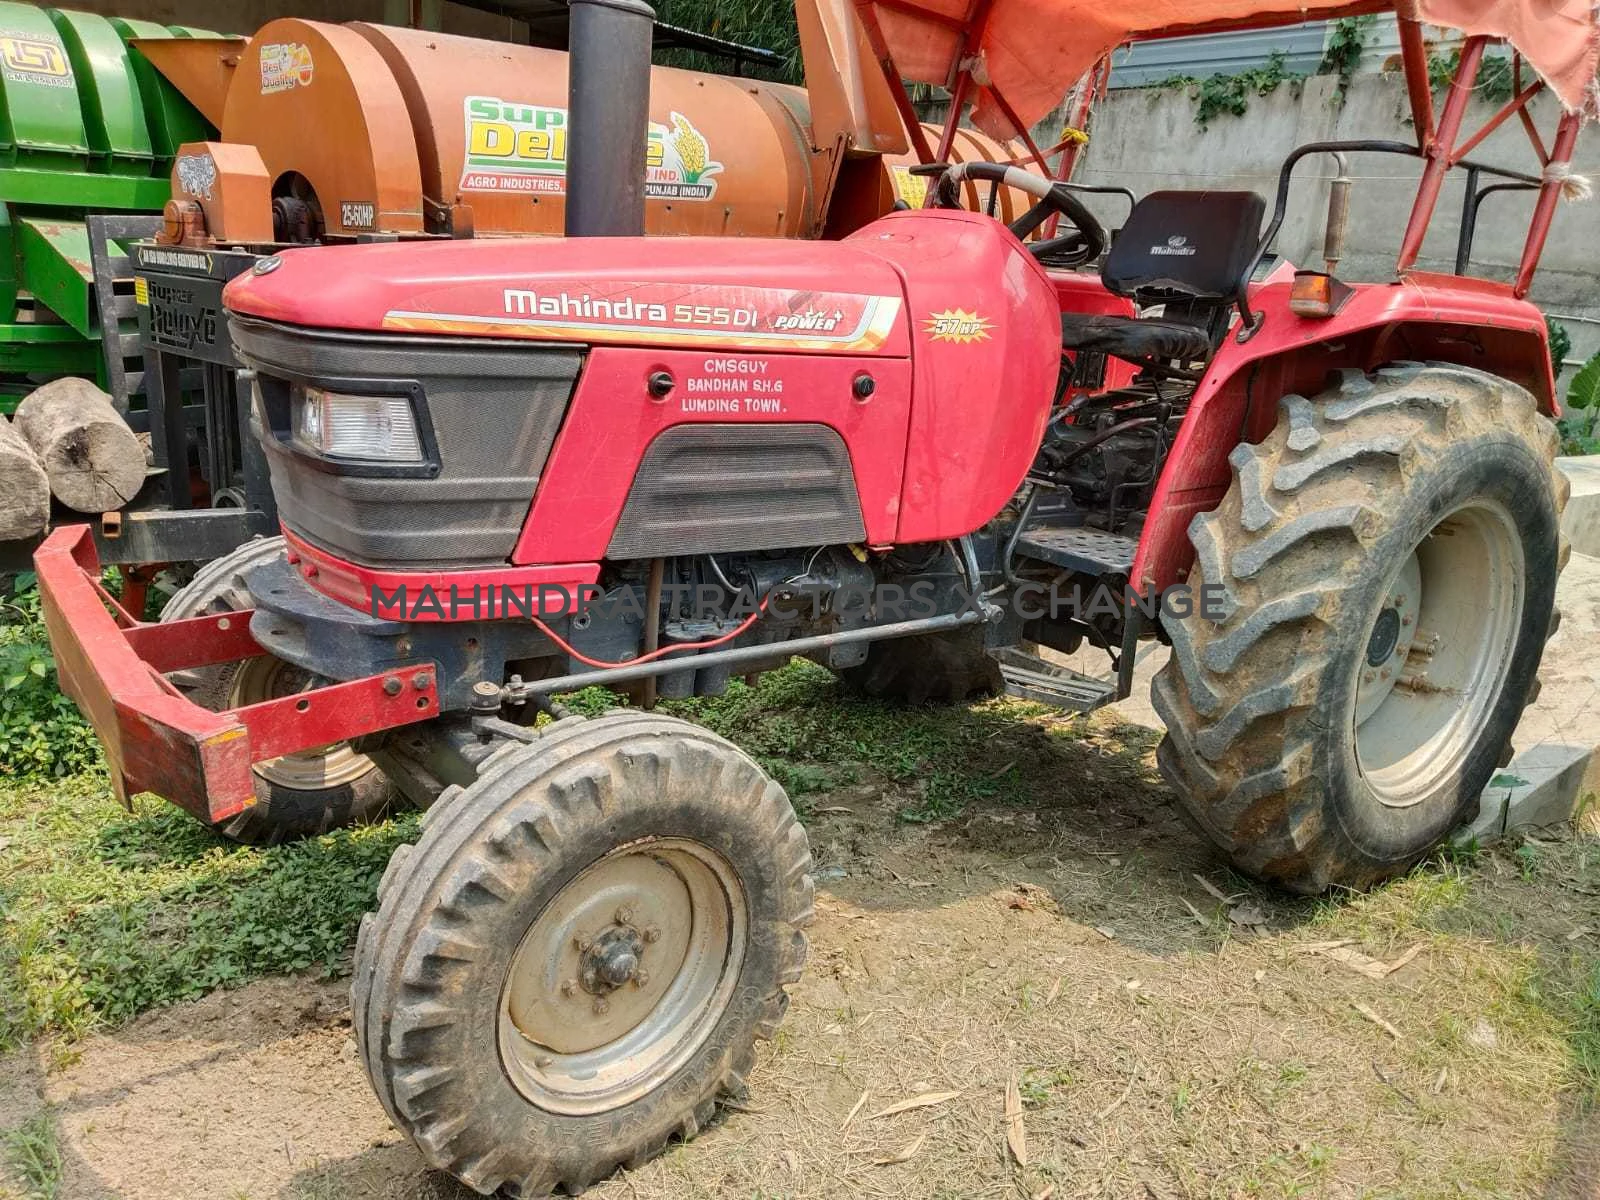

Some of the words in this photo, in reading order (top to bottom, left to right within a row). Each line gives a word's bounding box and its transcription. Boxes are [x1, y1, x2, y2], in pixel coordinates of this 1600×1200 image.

[467, 177, 497, 188] AGRO
[680, 186, 707, 198] (INDIA)
[342, 204, 374, 227] 25-60HP
[704, 359, 768, 373] CMSGUY
[687, 378, 748, 392] BANDHAN
[682, 399, 740, 412] LUMDING
